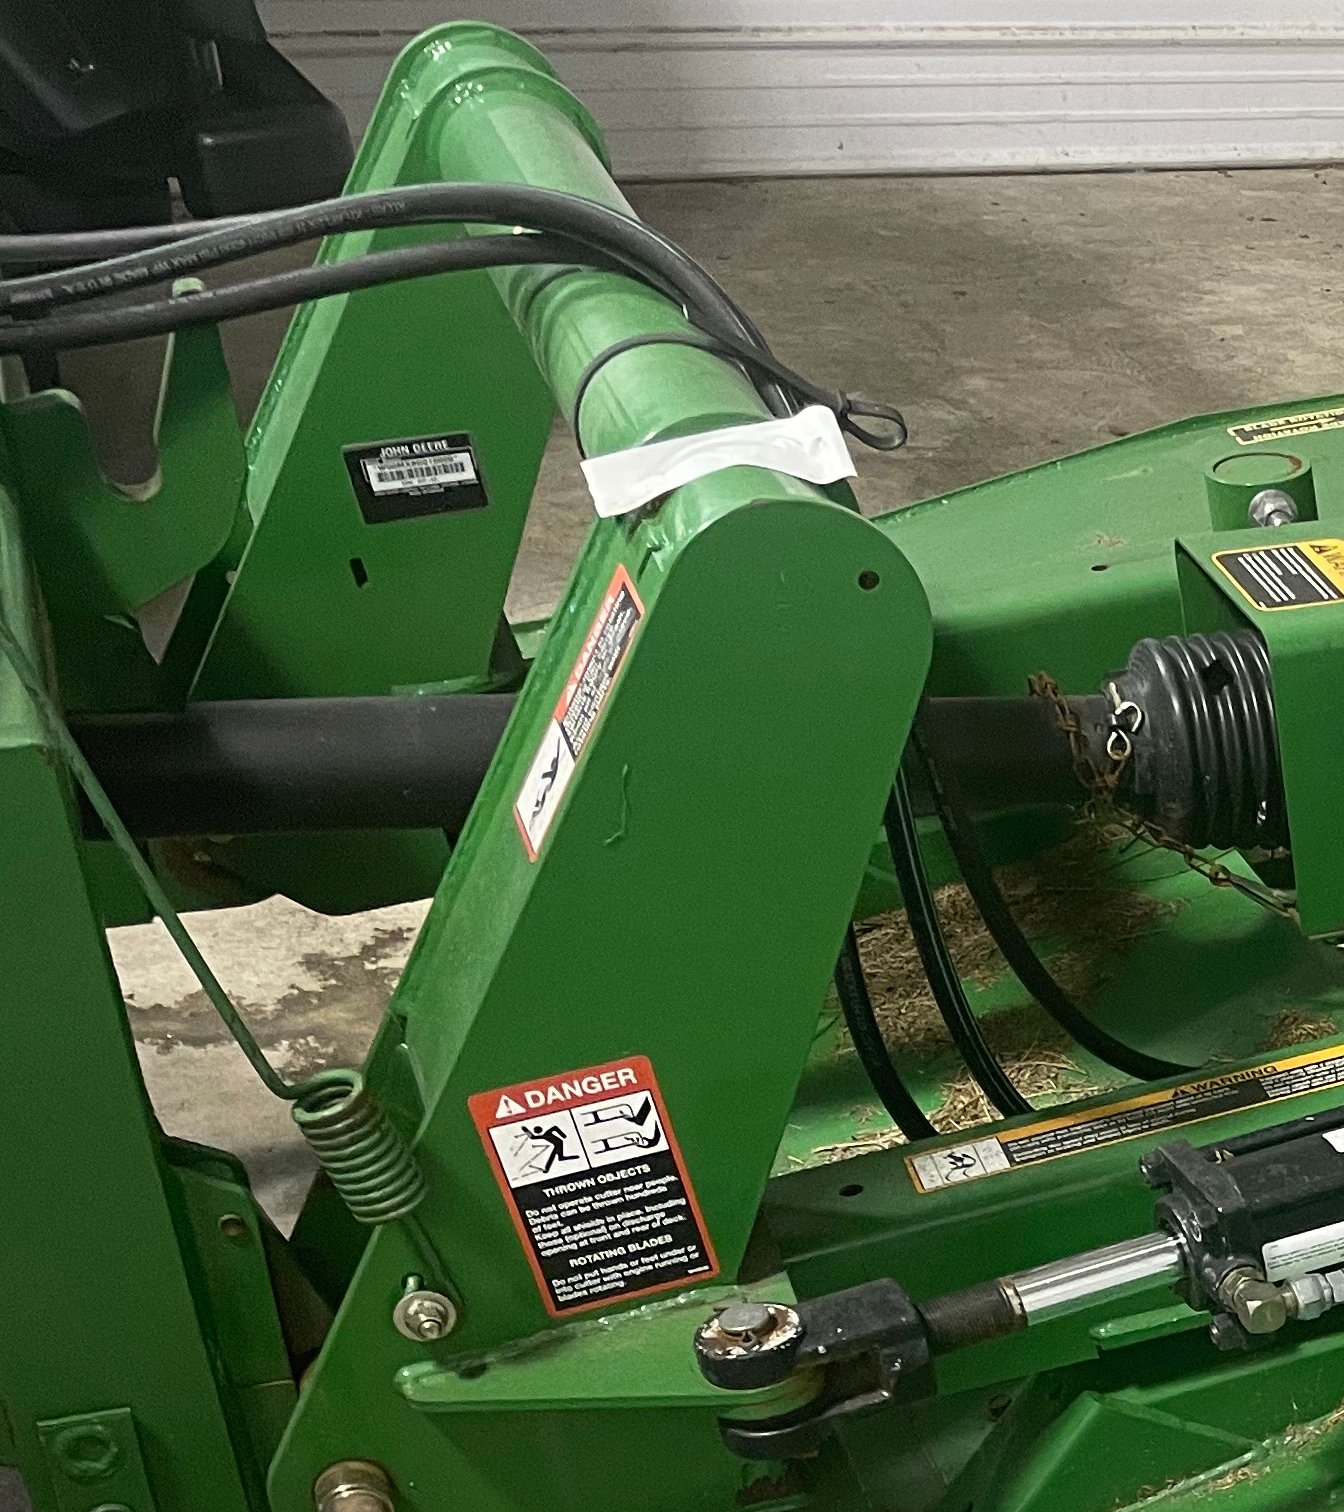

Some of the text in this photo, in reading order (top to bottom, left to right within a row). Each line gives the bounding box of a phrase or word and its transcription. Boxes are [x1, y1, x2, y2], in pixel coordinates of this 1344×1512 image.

[380, 445, 409, 459] JOHN
[523, 1067, 638, 1109] DANGER
[1191, 1065, 1278, 1092] WARNING
